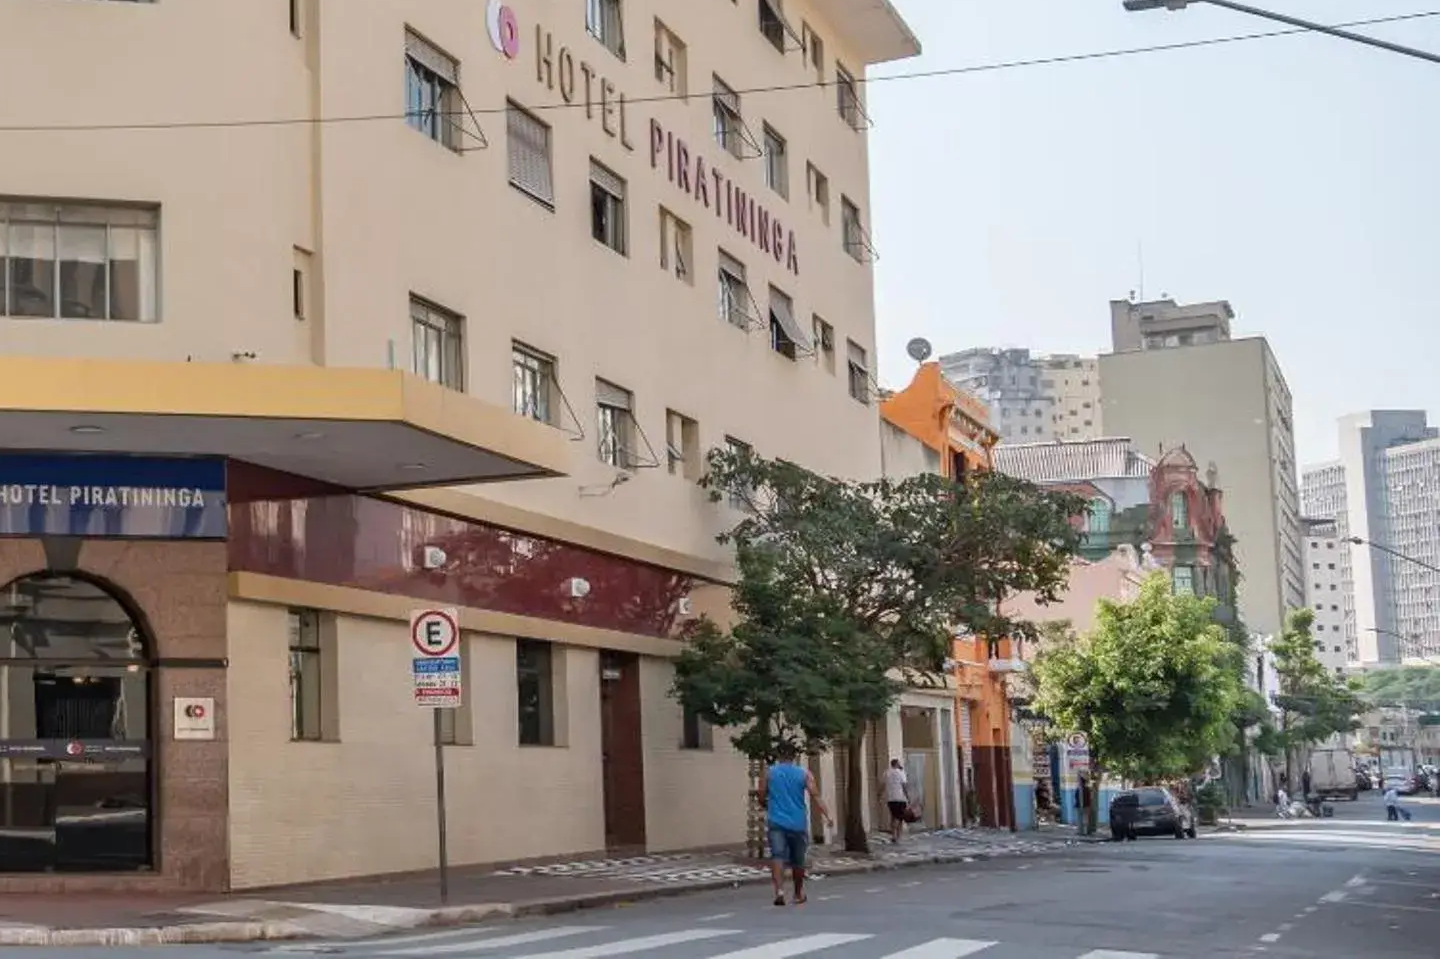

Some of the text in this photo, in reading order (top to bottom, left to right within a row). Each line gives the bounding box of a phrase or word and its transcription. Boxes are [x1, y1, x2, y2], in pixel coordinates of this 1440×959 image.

[536, 23, 799, 275] HOTEL PIRATININGA
[70, 486, 205, 508] PIRATININGA
[426, 620, 442, 646] E
